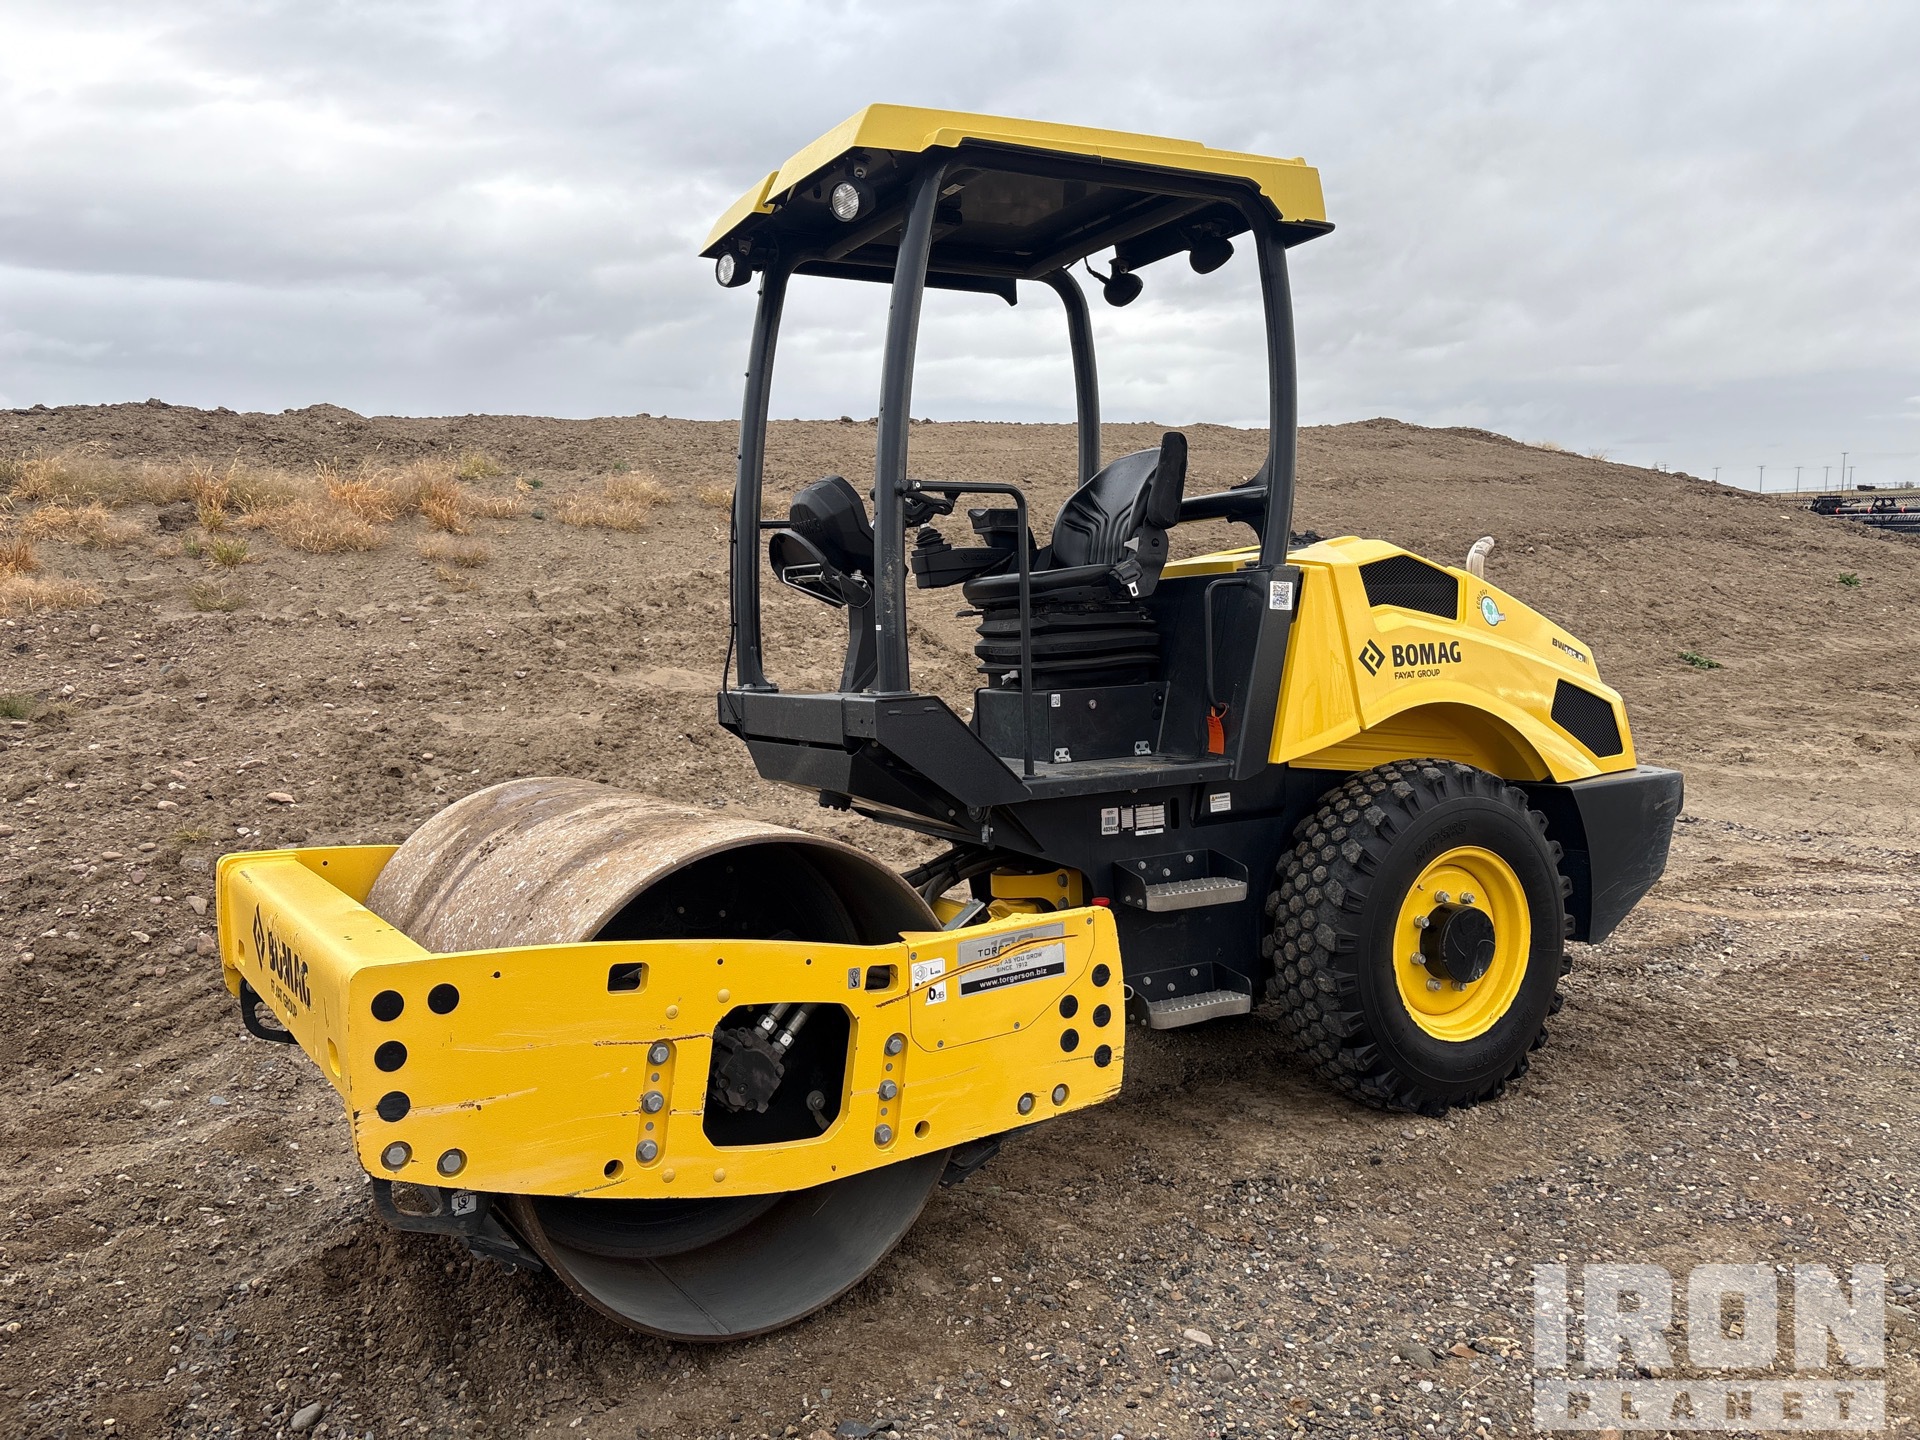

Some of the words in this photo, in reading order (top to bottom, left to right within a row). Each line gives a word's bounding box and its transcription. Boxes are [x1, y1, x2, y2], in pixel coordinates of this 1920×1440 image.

[1391, 640, 1462, 668] BOMAG
[1394, 670, 1415, 680] FAYAT
[1417, 668, 1441, 678] GROUP
[1013, 955, 1025, 963] YOU
[1026, 952, 1043, 960] GROW
[267, 928, 311, 1011] BOMAG
[996, 964, 1012, 973] SINCE
[979, 969, 1048, 988] www.torgerson.biz
